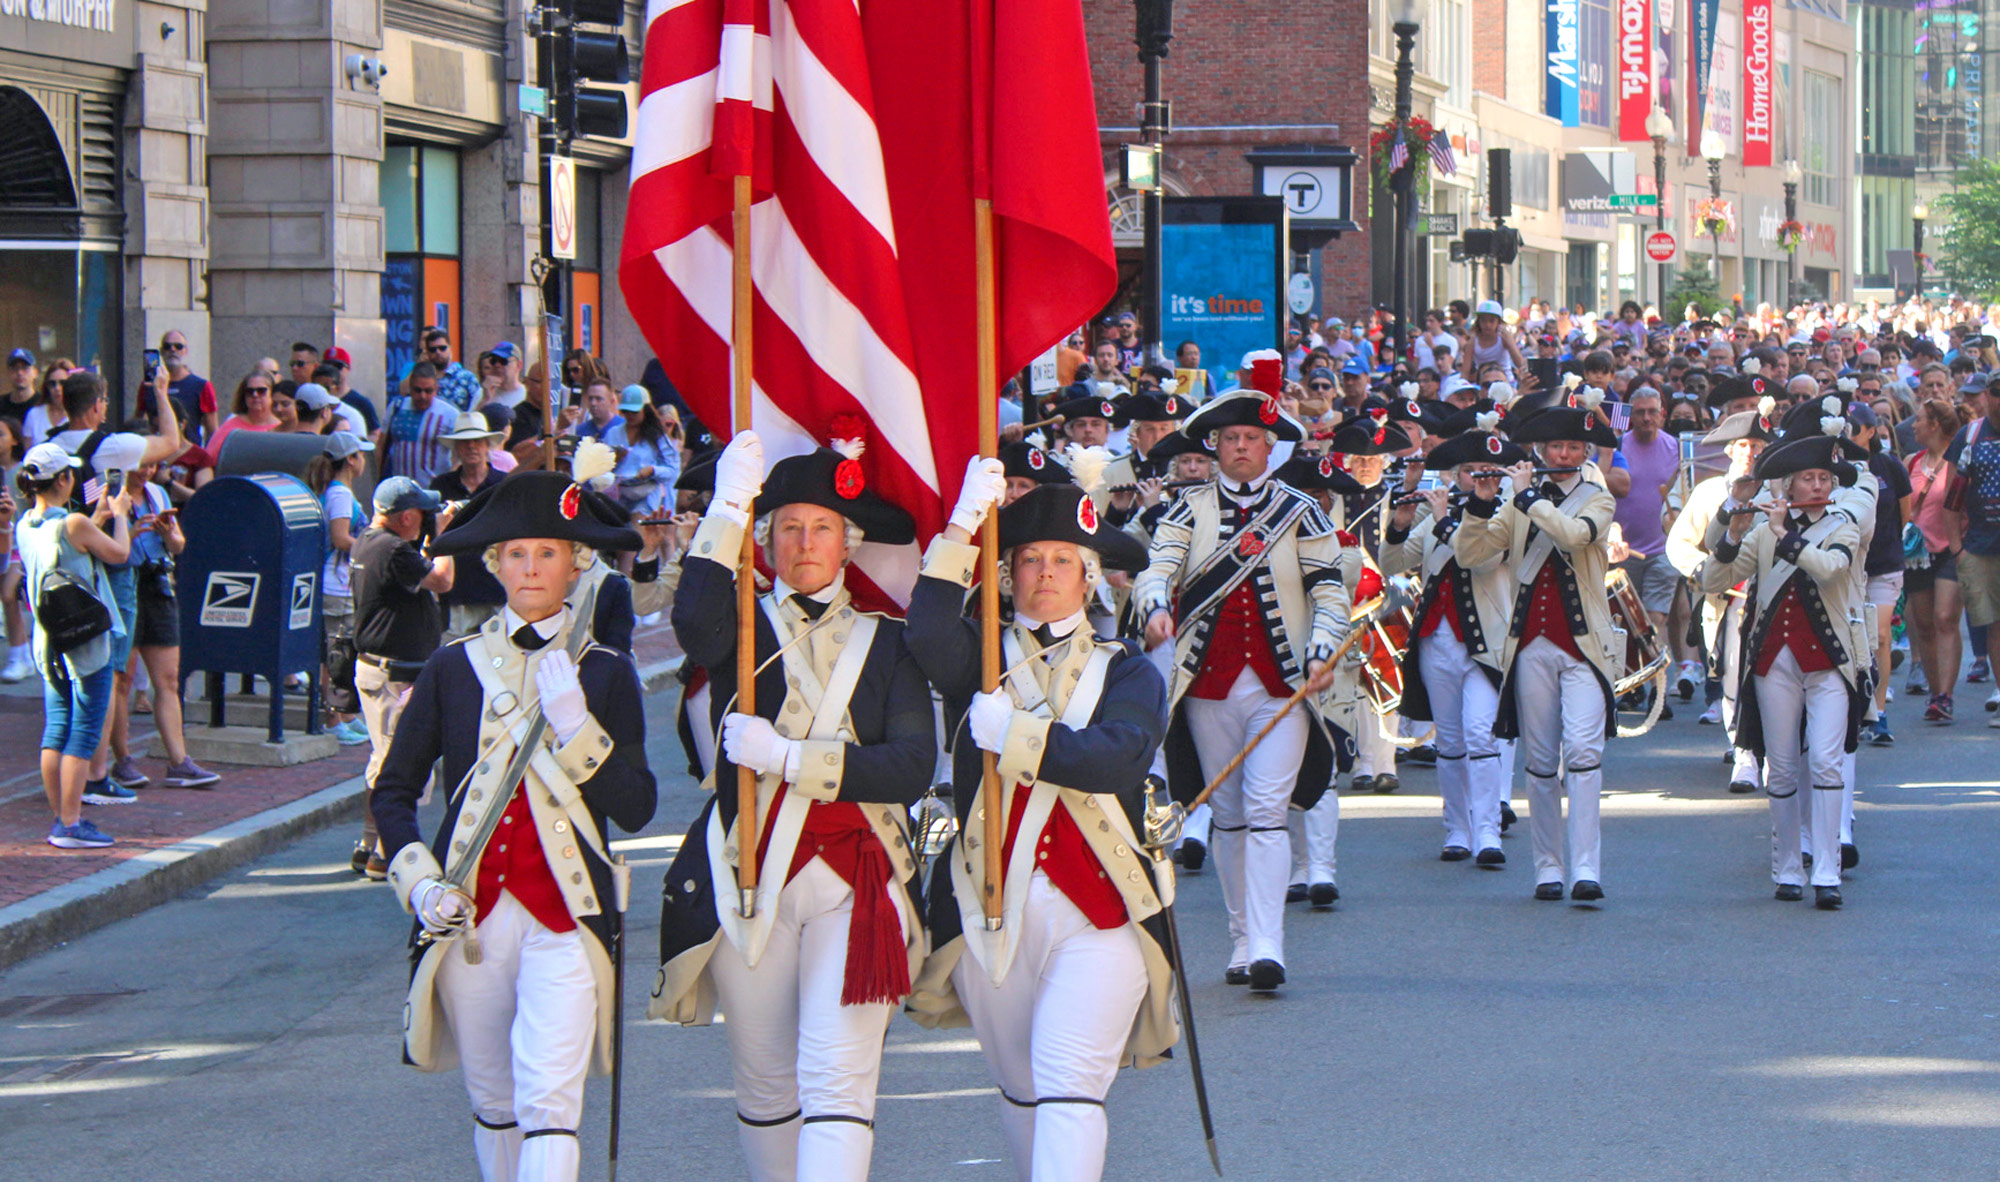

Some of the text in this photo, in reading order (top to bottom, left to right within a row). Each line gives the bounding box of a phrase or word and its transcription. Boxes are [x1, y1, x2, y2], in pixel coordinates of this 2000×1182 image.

[1746, 5, 1769, 144] HomeGoods
[1288, 184, 1315, 207] T
[1171, 294, 1205, 314] it's
